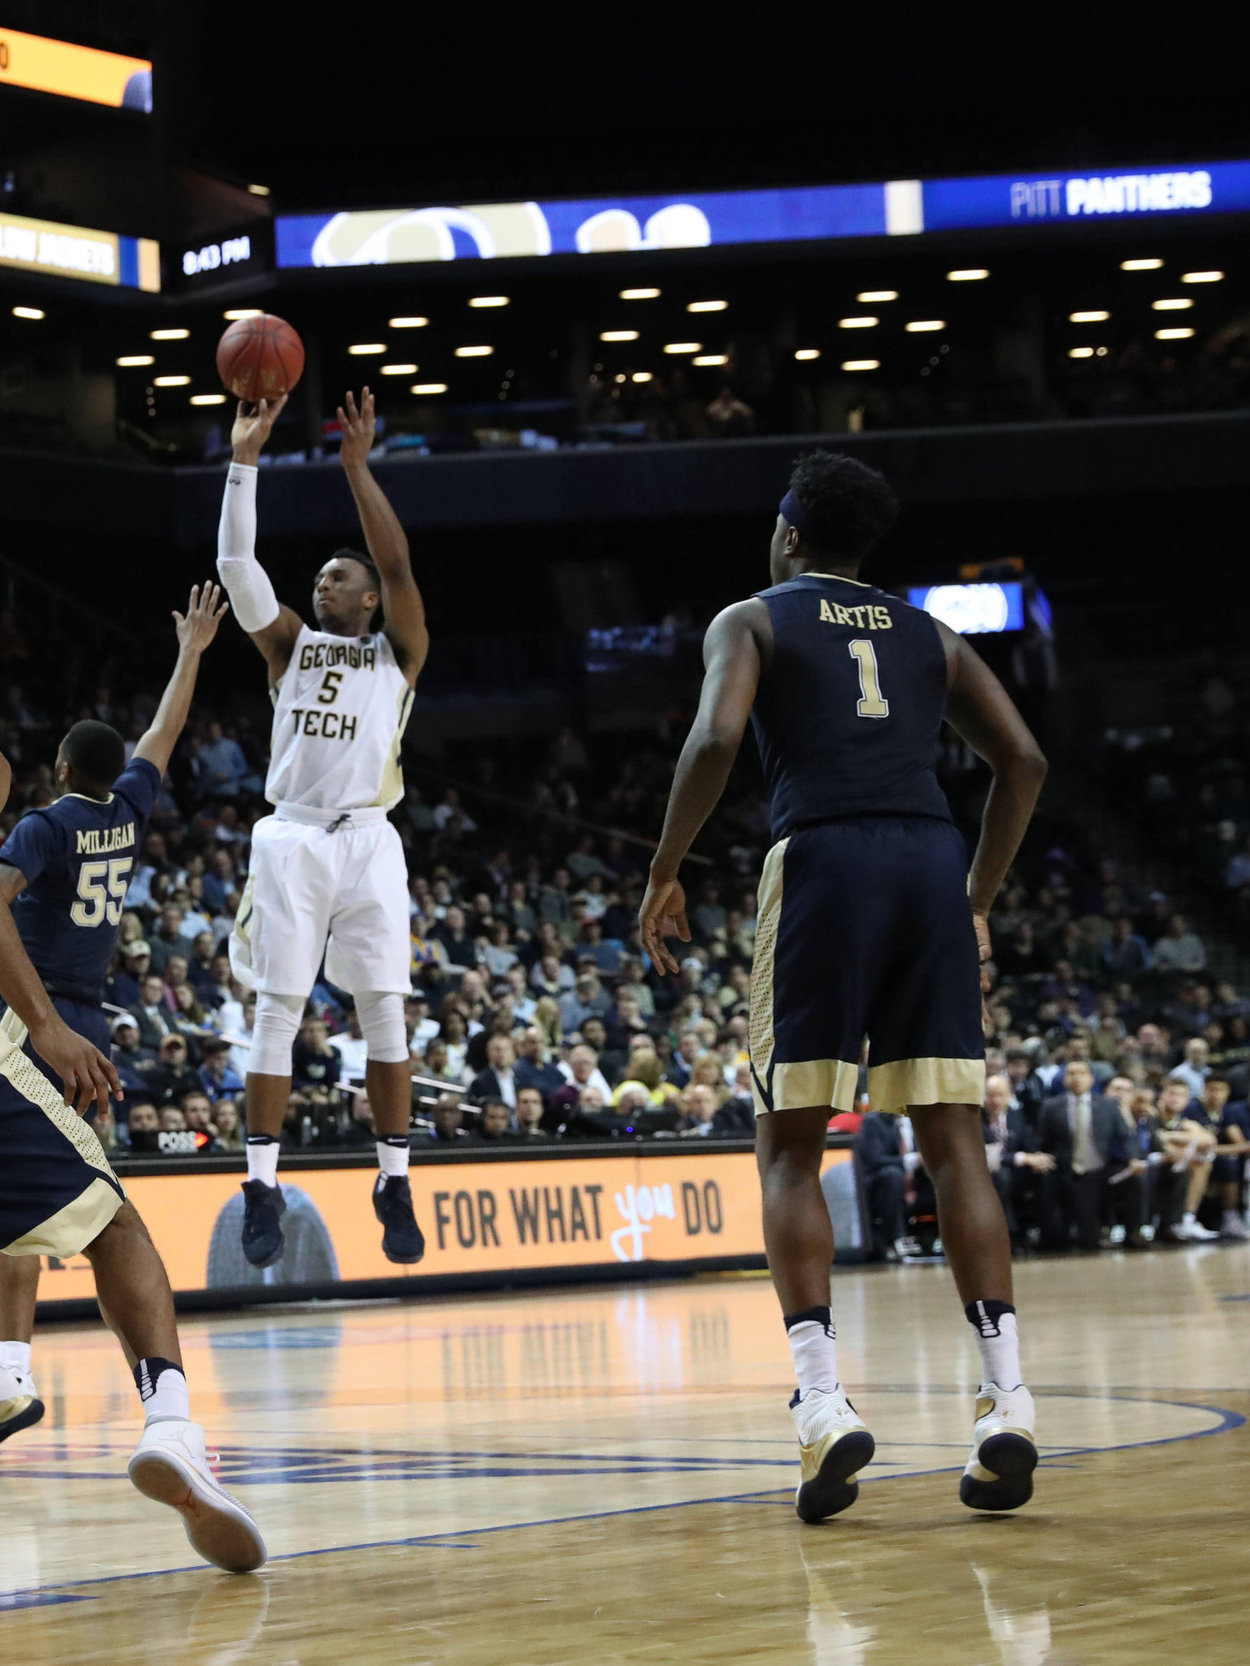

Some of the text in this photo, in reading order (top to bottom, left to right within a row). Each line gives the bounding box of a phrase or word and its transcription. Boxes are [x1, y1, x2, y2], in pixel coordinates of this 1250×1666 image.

[1010, 170, 1212, 218] PITT PANTHERS
[819, 599, 893, 630] ARTIS
[299, 643, 376, 672] GEORGIA
[317, 670, 344, 705] 5
[848, 639, 890, 718] 1
[291, 708, 358, 741] TECH
[76, 821, 135, 855] MILLIGAN
[70, 856, 134, 928] 55
[158, 1131, 199, 1154] POSS
[433, 1178, 723, 1262] FOR WHAT you DO
